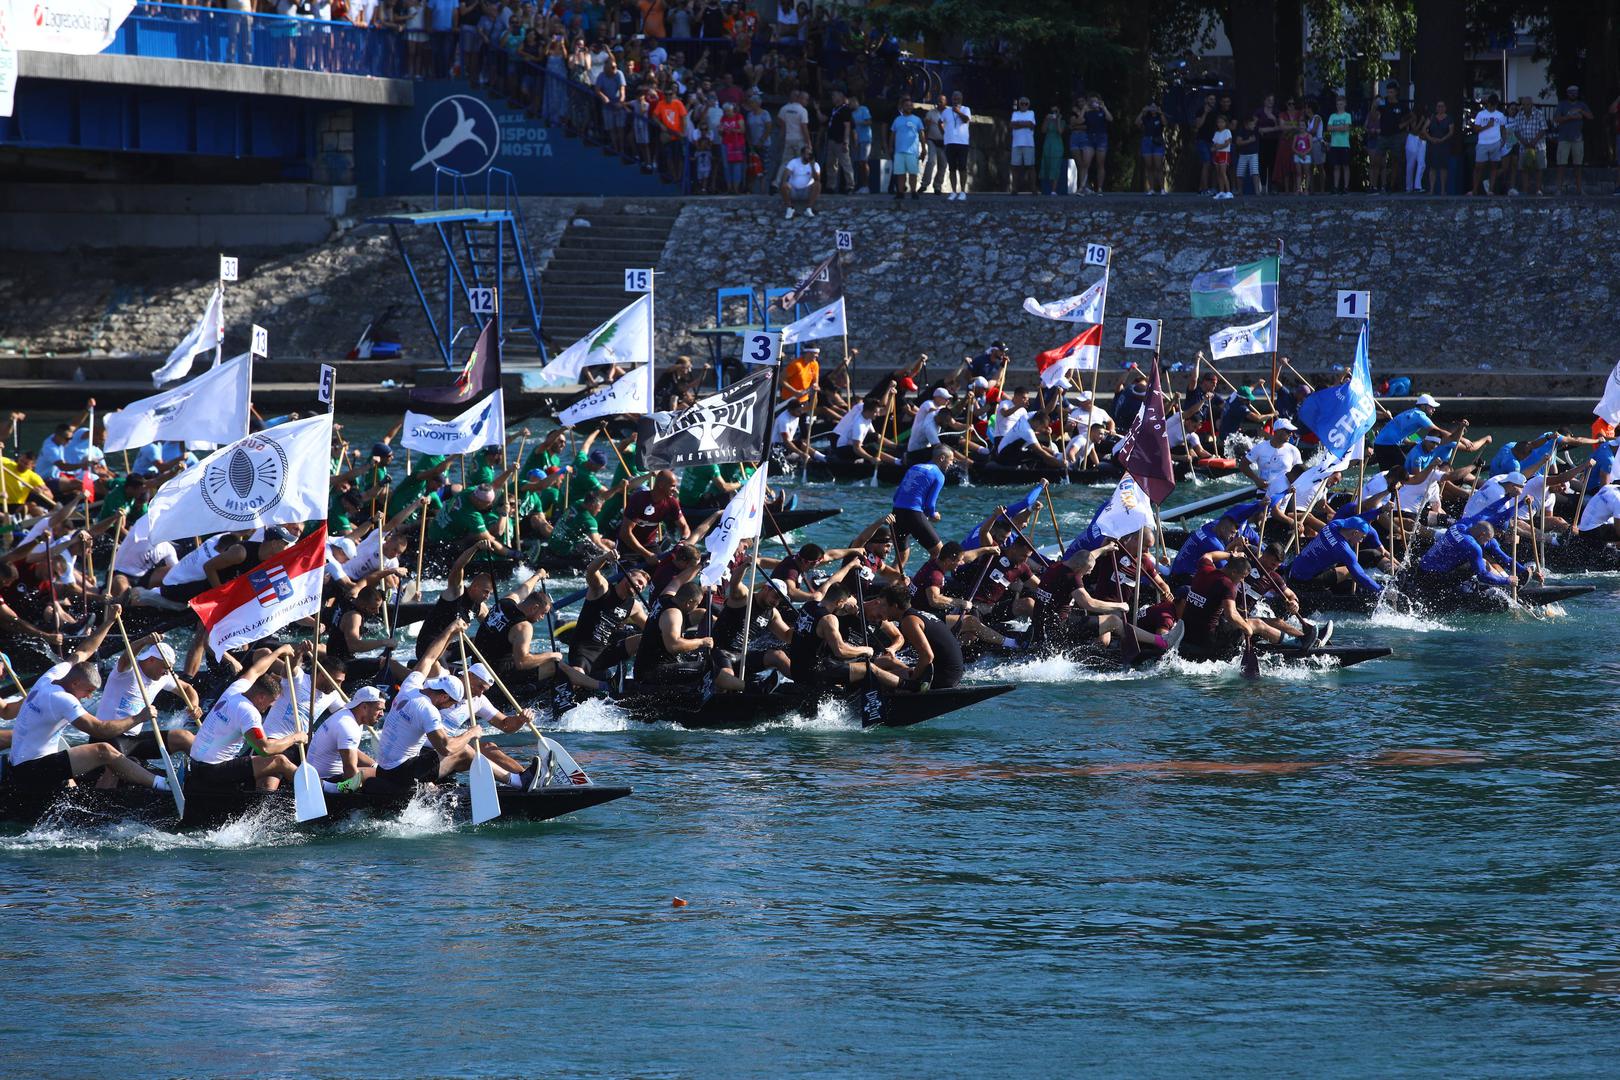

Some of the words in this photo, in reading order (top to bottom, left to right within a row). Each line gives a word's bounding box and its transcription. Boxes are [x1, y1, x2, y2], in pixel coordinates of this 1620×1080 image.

[501, 128, 548, 141] ISPOD
[501, 143, 553, 157] MOSTA
[838, 233, 850, 247] 29
[1088, 246, 1106, 264] 19
[224, 260, 236, 278] 33
[627, 271, 647, 289] 15
[471, 290, 492, 310] 12
[1343, 294, 1357, 314] 1
[255, 329, 266, 352] 13
[1133, 322, 1153, 345] 2
[751, 335, 771, 361] 3
[322, 369, 332, 399] 5
[711, 396, 756, 430] PUT
[1328, 394, 1374, 448] STAB
[676, 447, 737, 462] METKOVIĆ
